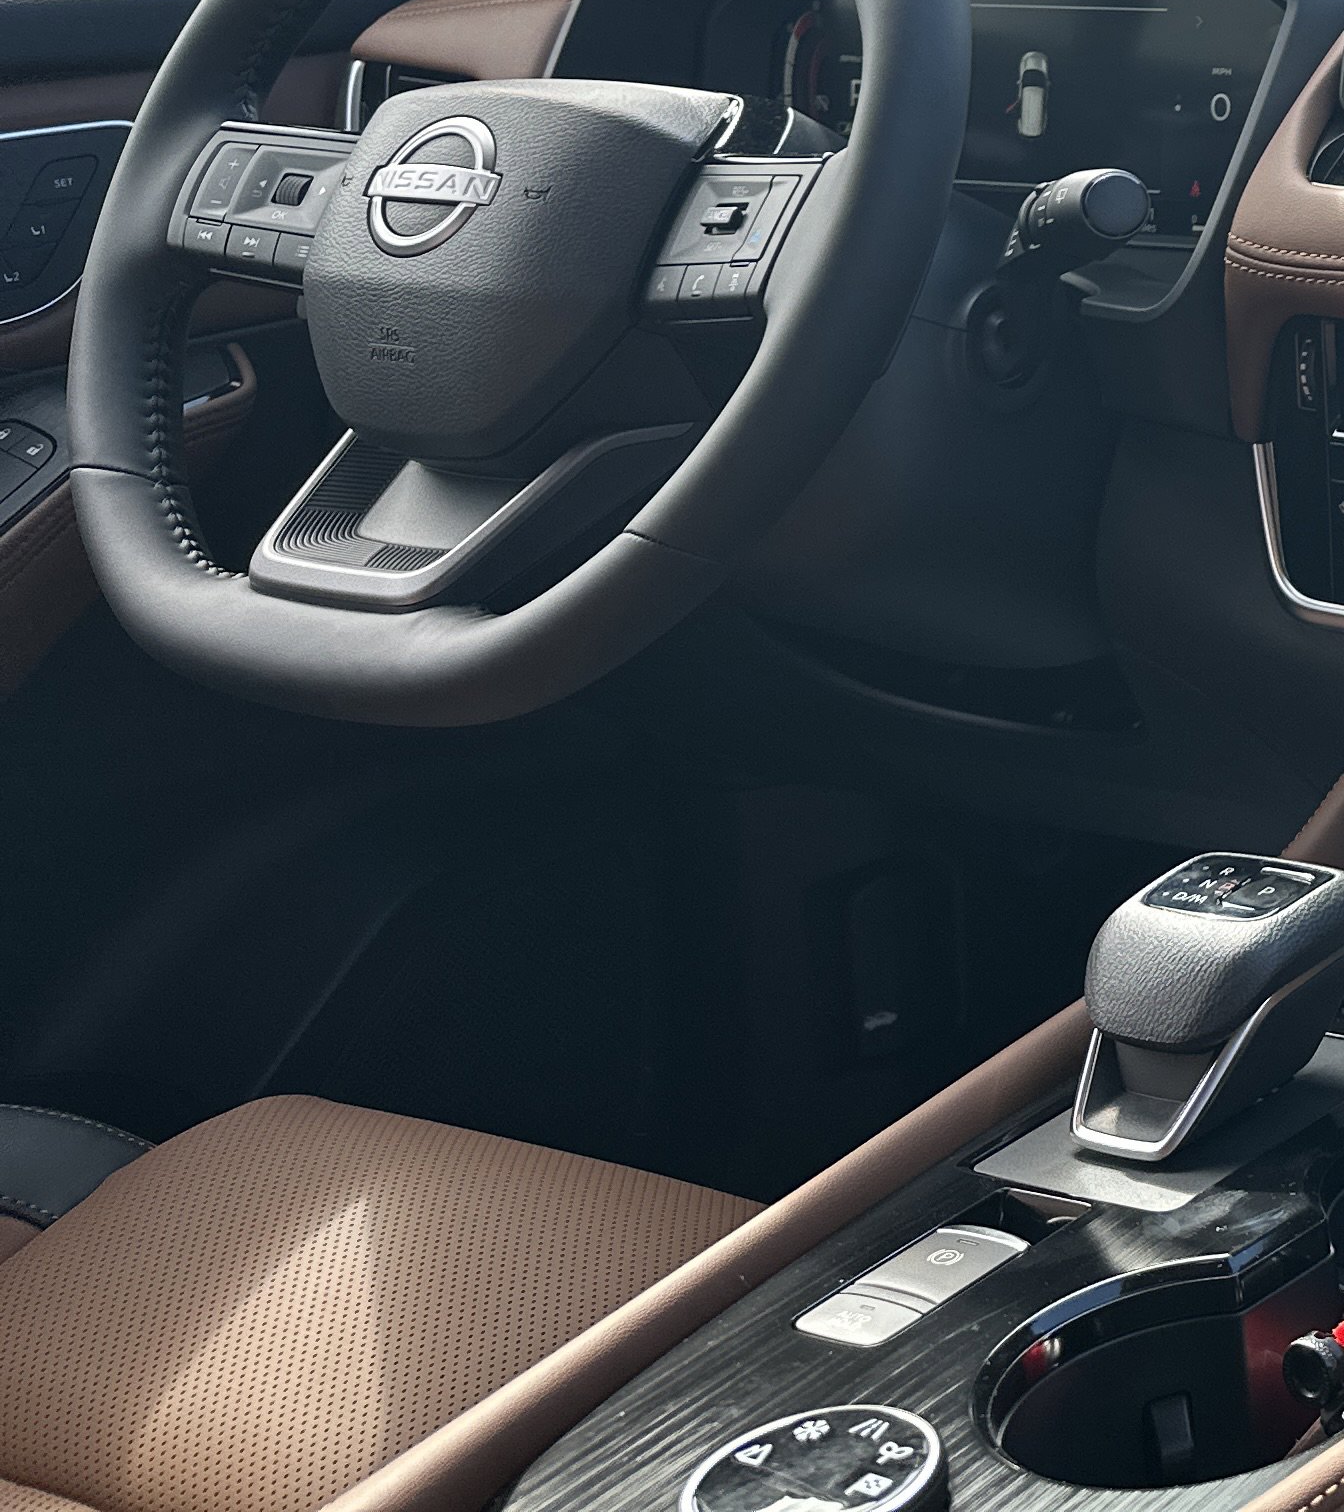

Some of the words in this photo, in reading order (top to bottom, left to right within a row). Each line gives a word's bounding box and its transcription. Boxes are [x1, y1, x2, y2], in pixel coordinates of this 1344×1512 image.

[1211, 93, 1231, 121] 0
[54, 178, 73, 188] SET
[376, 169, 495, 199] NISSAN
[380, 327, 399, 342] SRS
[370, 349, 415, 364] AIRBAG
[1219, 867, 1234, 875] R
[1199, 880, 1217, 888] N
[1258, 887, 1275, 895] P
